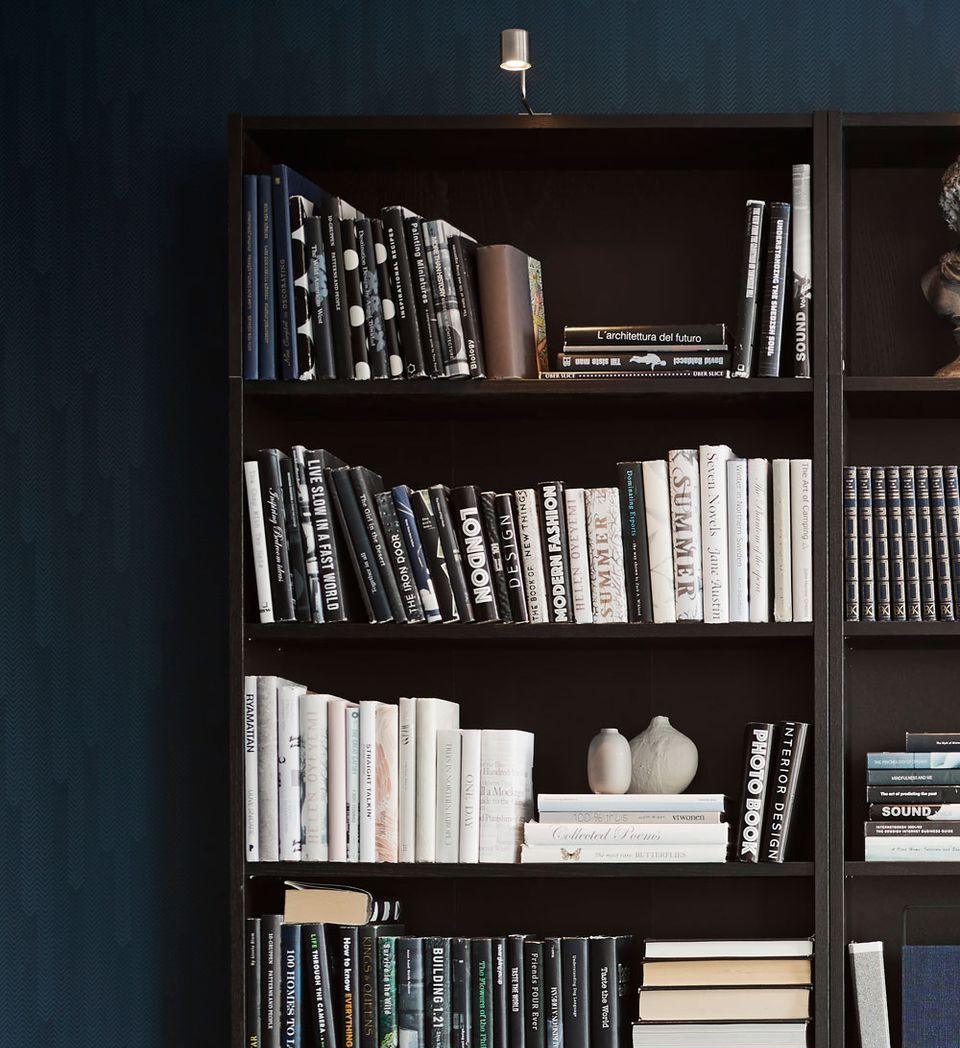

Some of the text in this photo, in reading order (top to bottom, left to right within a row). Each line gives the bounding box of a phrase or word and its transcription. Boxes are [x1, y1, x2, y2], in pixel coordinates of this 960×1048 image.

[411, 223, 428, 304] Painting Miniatures
[772, 220, 784, 284] UNDERSTANDING
[388, 228, 405, 318] INSPIRATIONAL RECIPES
[676, 333, 702, 342] futuro
[768, 300, 778, 335] SWEDISH
[795, 312, 806, 361] SOUND
[467, 340, 478, 370] Biology
[307, 460, 322, 483] LIVE
[310, 487, 326, 516] SLOW
[360, 494, 369, 507] The
[362, 508, 372, 524] Girl
[626, 470, 637, 536] Dominating Esports
[316, 518, 328, 531] IN
[370, 532, 378, 543] the
[673, 475, 695, 598] SUMMER
[706, 452, 722, 620] Seven Novels Jane Austin
[801, 505, 810, 540] Camping
[320, 544, 334, 570] FAST
[374, 544, 386, 566] Desert
[460, 507, 492, 604] LONDON
[500, 515, 520, 588] DESIGN
[542, 486, 568, 623] MODERN FASHION
[595, 517, 614, 618] SUMMER
[323, 573, 339, 611] WORLD
[391, 534, 418, 614] THE IRON DOOR
[246, 694, 255, 753] RYAMATTAN
[741, 729, 768, 855] PHOTO BOOK
[768, 722, 795, 859] INTERIOR DESIGN
[882, 807, 931, 817] SOUND
[552, 824, 661, 842] Collected Poems
[286, 949, 295, 968] 100
[343, 937, 351, 957] How
[344, 958, 351, 967] to
[362, 936, 372, 973] KINGS
[286, 971, 295, 1016] HOMES
[432, 948, 444, 1028] BUILDING 1.21
[531, 952, 539, 1030] Friends FOUR Ever
[286, 1018, 295, 1036] TO
[344, 992, 353, 1048] EVERYTHING
[363, 984, 373, 1036] QUEENS
